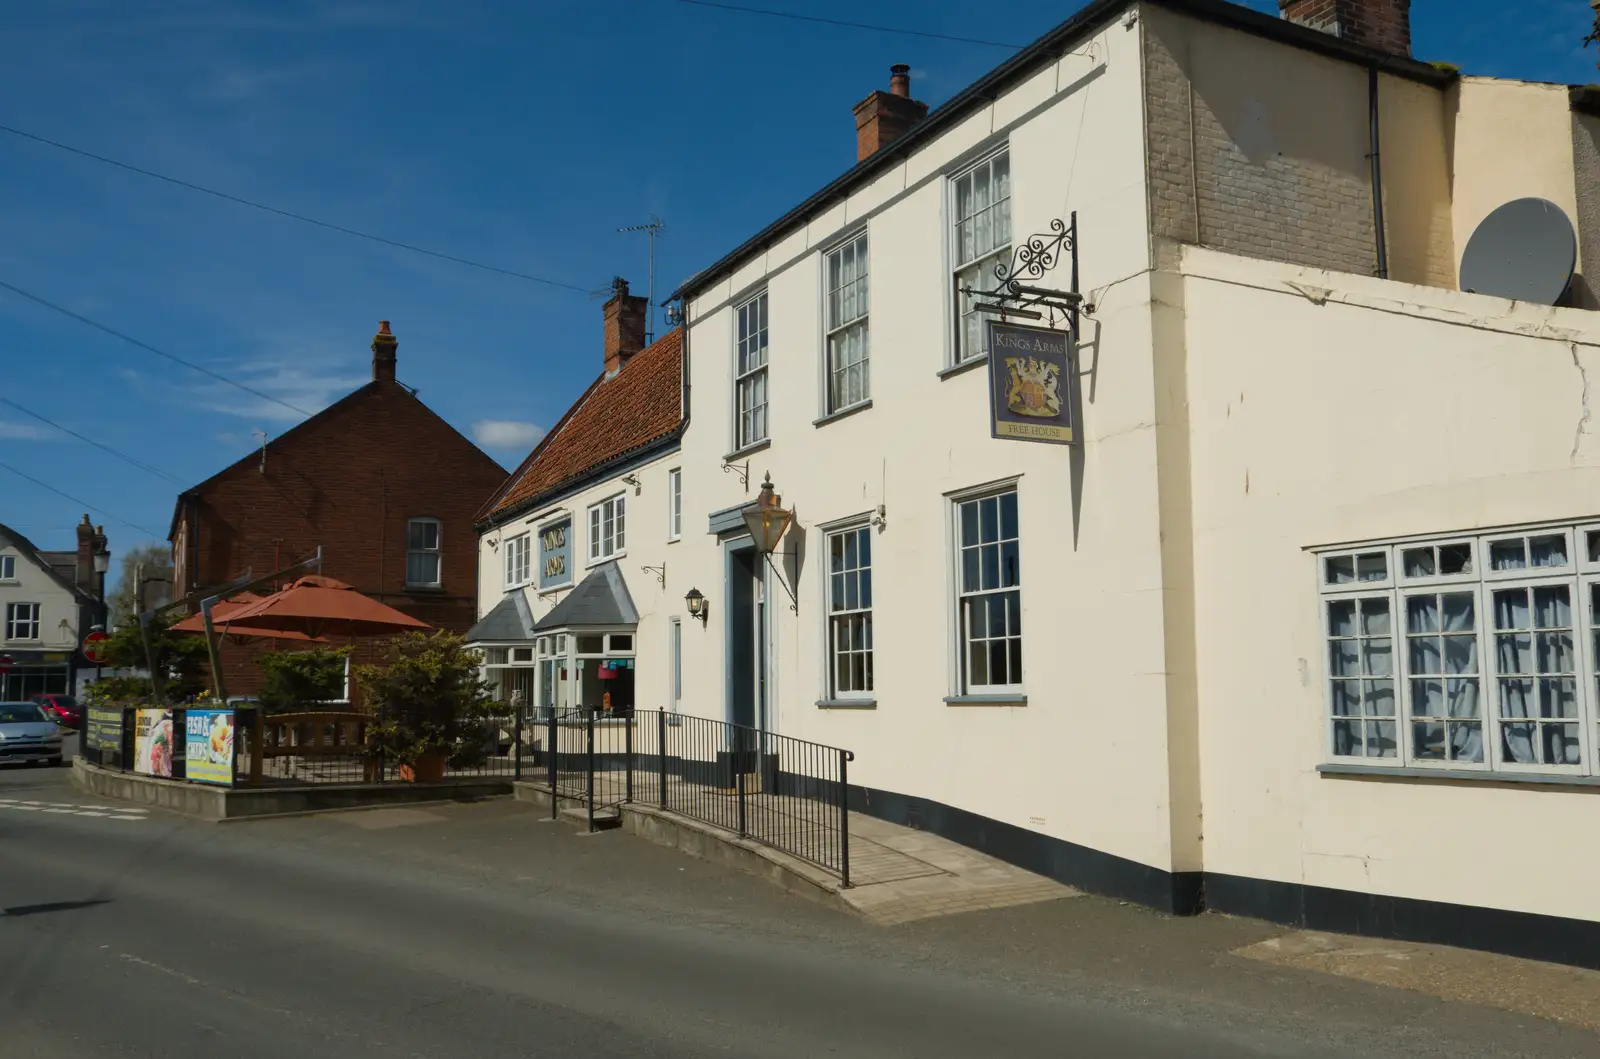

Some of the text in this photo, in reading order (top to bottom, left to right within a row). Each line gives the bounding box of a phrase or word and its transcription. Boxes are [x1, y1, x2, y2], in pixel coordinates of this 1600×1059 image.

[1033, 339, 1064, 354] ARMS
[1008, 424, 1061, 437] FREE HOUSE
[187, 716, 203, 735] FISH
[187, 741, 207, 761] CHIPS
